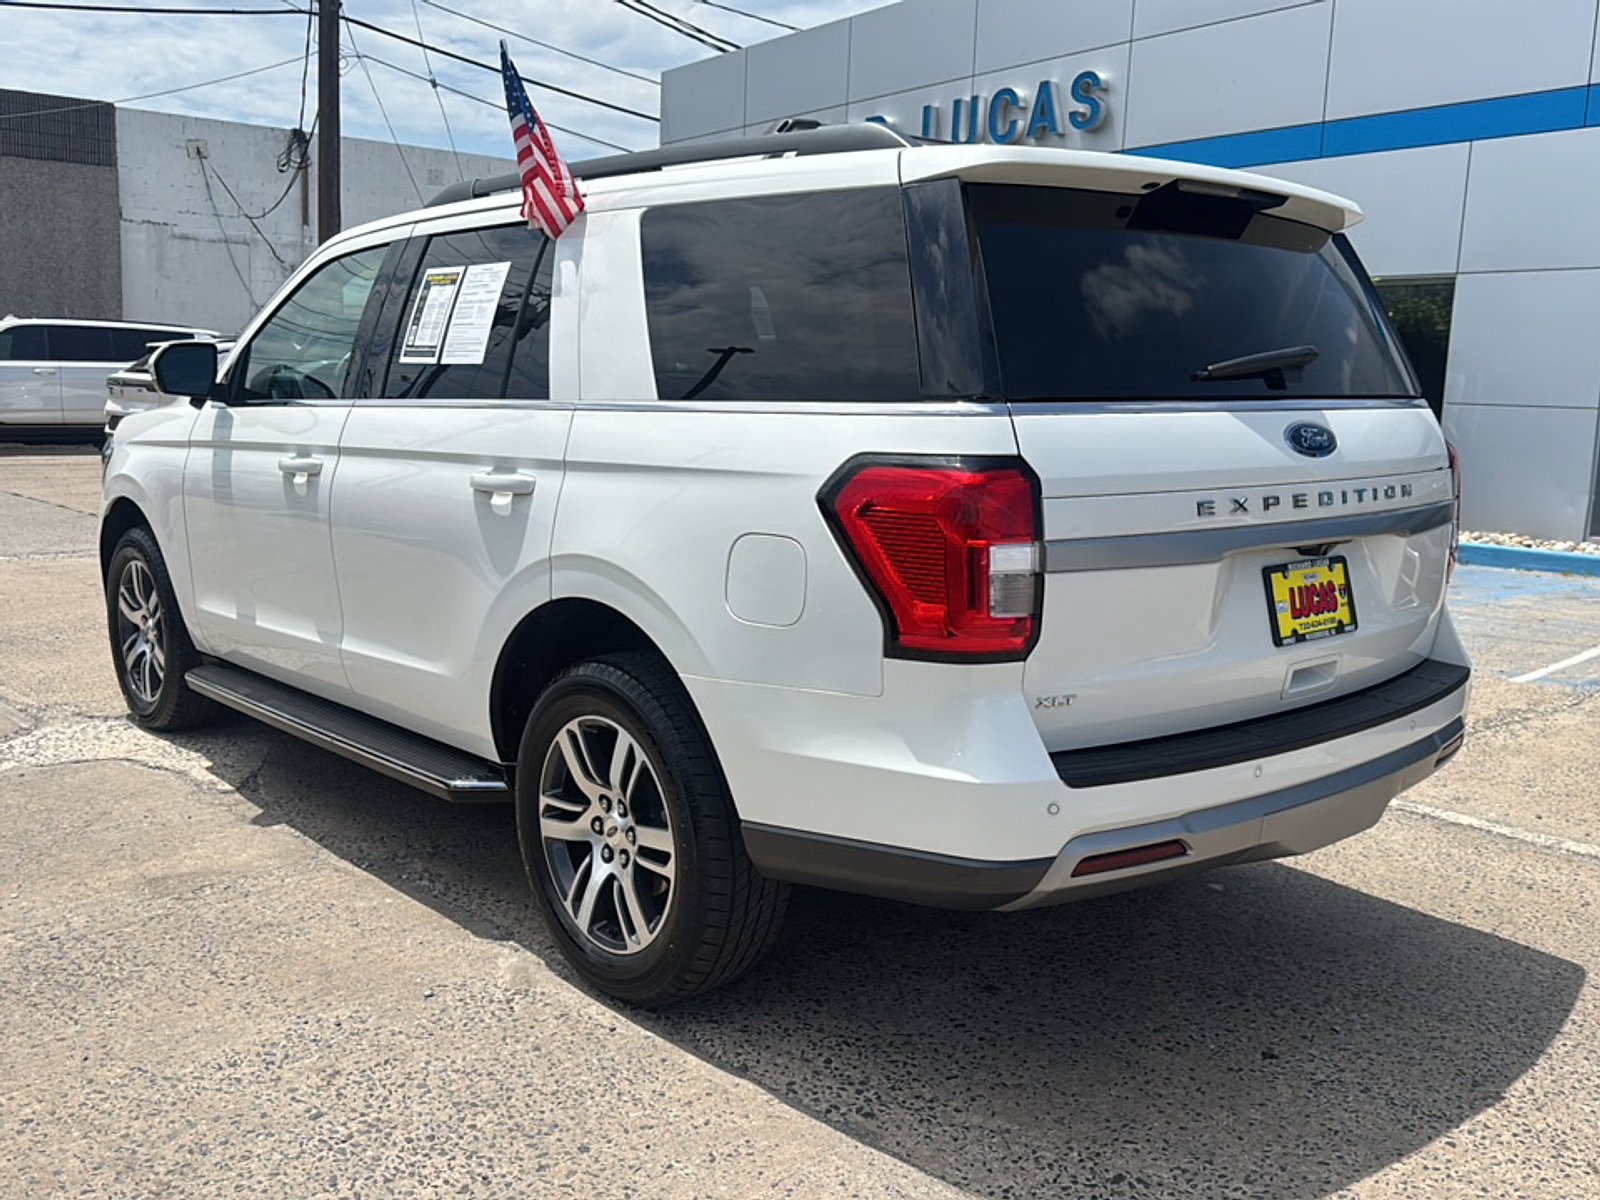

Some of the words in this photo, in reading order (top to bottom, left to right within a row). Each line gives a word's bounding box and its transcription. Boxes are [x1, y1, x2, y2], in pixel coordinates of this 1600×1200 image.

[1301, 427, 1329, 448] Ford
[1196, 482, 1413, 517] EXPEDITION
[1288, 580, 1338, 619] LUCAS
[1035, 694, 1078, 709] XLT
